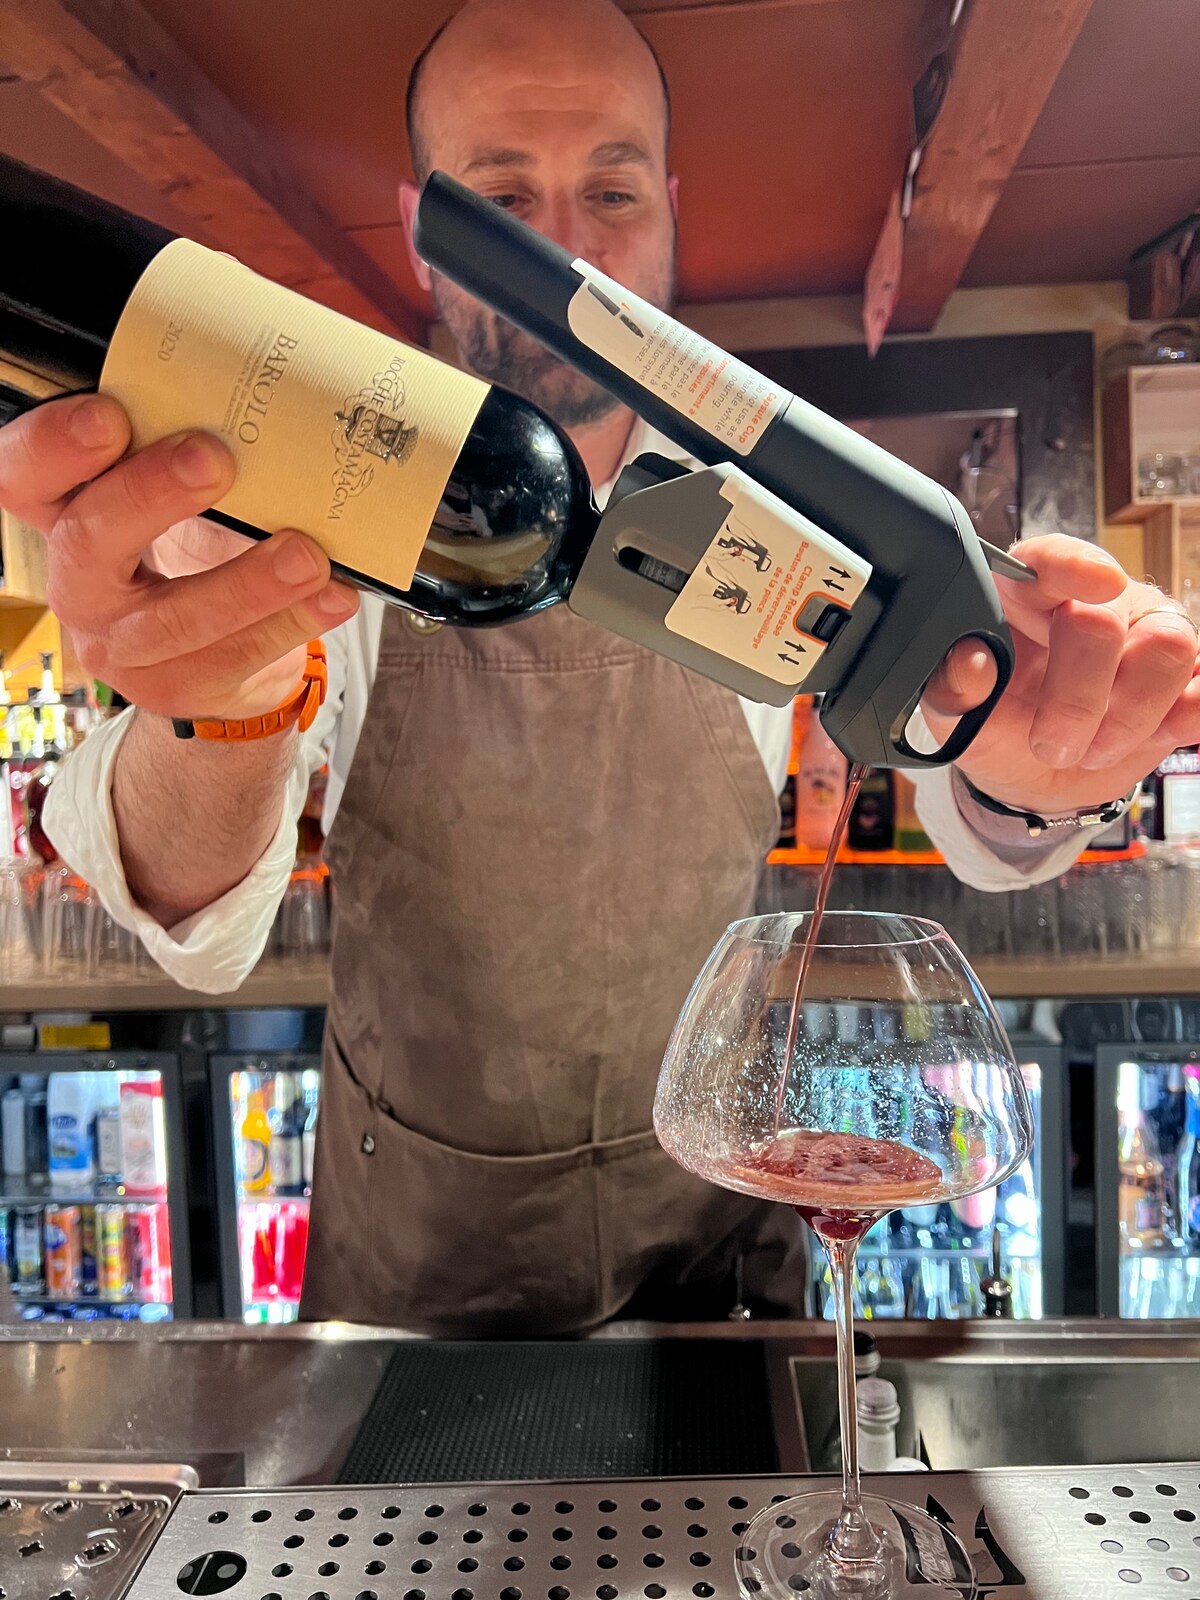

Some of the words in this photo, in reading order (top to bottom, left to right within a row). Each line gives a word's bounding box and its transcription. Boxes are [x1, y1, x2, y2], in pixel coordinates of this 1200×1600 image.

[155, 321, 184, 362] 2020
[633, 335, 655, 364] versez.
[637, 348, 663, 381] lorsque
[666, 364, 680, 381] par
[687, 358, 713, 394] capsules
[238, 333, 297, 444] BAROLO
[369, 356, 406, 408] ROCCHE
[660, 380, 671, 391] le
[670, 389, 680, 399] le
[676, 372, 689, 389] pas
[711, 374, 738, 411] pouring.
[730, 379, 753, 407] handle
[754, 383, 767, 394] Do
[745, 392, 759, 408] not
[750, 391, 777, 425] Capsule
[713, 406, 735, 433] while
[734, 407, 748, 424] use
[725, 425, 737, 438] as
[737, 424, 755, 444] Cup
[326, 407, 379, 522] COSTAMAGNA
[789, 540, 809, 572] Bouton
[768, 578, 777, 589] la
[772, 566, 784, 579] de
[782, 572, 794, 585] de
[791, 564, 812, 597] Clamp
[755, 588, 773, 614] pince
[751, 585, 788, 649] déverrouillage
[772, 597, 797, 637] Release
